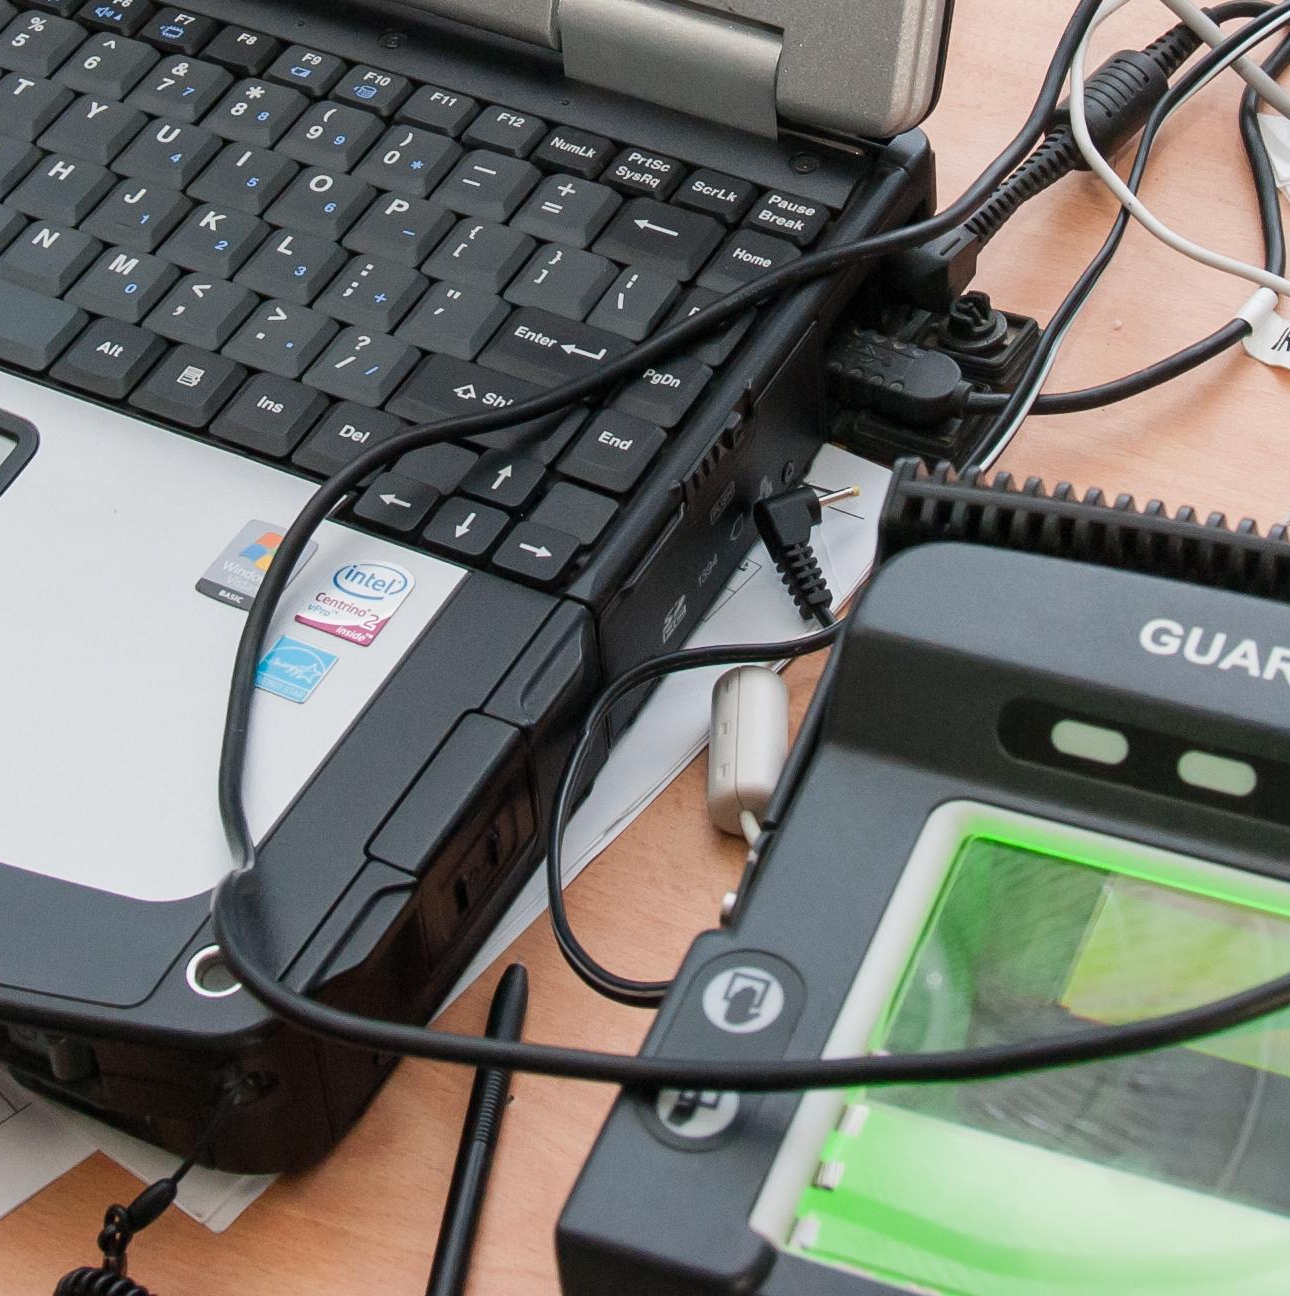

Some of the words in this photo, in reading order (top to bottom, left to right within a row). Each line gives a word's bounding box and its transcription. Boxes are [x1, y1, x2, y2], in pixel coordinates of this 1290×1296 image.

[172, 14, 195, 28] F7
[12, 34, 29, 46] 5
[237, 33, 257, 44] F8
[84, 56, 100, 69] 6
[302, 53, 321, 65] F9
[14, 79, 34, 94] T
[157, 78, 175, 90] 7
[361, 72, 390, 89] F10
[431, 92, 457, 106] F11
[88, 102, 108, 118] Y
[231, 103, 247, 115] 8
[497, 113, 524, 127] F12
[157, 125, 180, 142] U
[306, 126, 323, 139] 9
[551, 137, 595, 157] NumLk
[237, 152, 251, 166] I
[384, 151, 400, 164] 0
[627, 152, 671, 172] PrtSc
[48, 161, 74, 180] H
[615, 165, 661, 188] SysRq
[310, 175, 333, 192] O
[692, 181, 737, 201] ScrLk
[124, 189, 146, 203] J
[385, 199, 409, 214] P
[767, 194, 816, 216] Pause
[200, 211, 226, 230] K
[758, 210, 805, 232] Break
[32, 229, 59, 248] N
[277, 236, 292, 255] L
[109, 254, 139, 275] M
[733, 248, 771, 267] Home
[515, 326, 557, 347] Enter
[97, 342, 123, 357] Alt
[644, 370, 680, 387] PgDn
[257, 396, 283, 413] Ins
[339, 425, 370, 443] Del
[598, 431, 632, 450] End
[222, 560, 261, 583] Windo
[218, 589, 244, 604] BASIC
